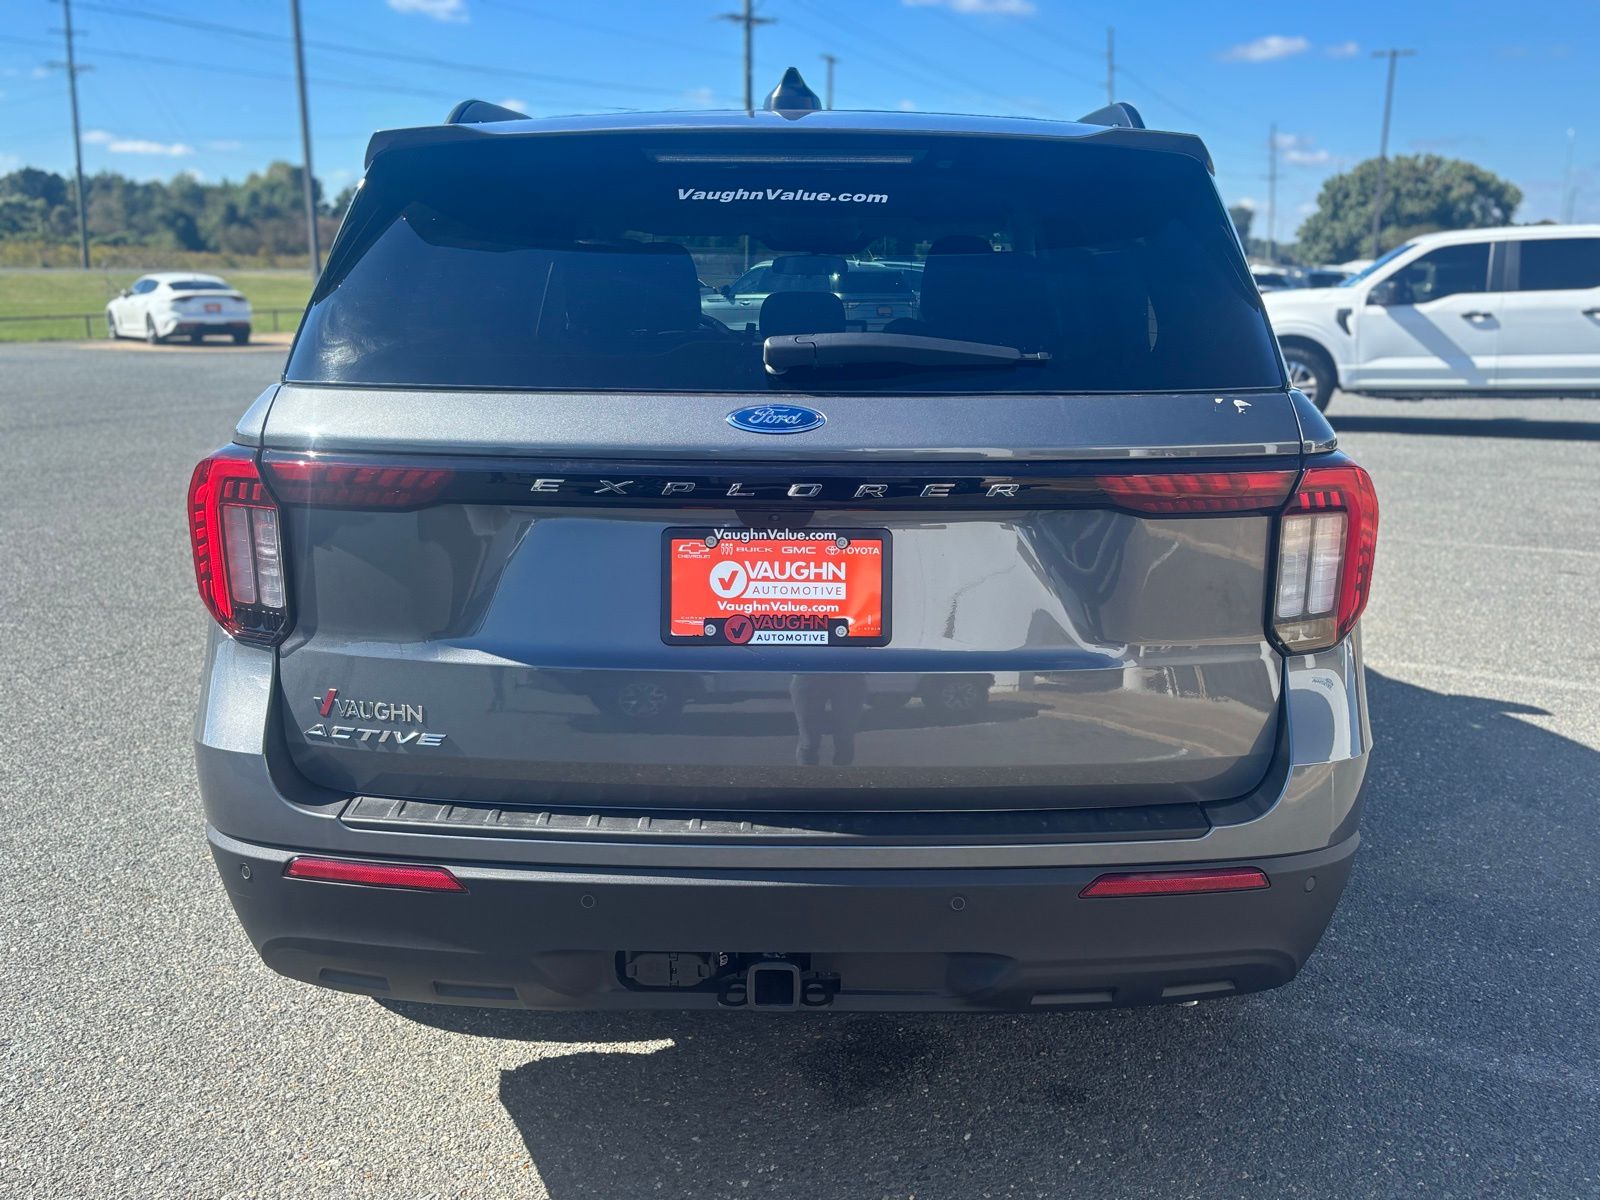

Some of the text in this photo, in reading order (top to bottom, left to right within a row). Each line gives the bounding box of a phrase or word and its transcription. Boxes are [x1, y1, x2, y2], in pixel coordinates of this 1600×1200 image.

[677, 188, 889, 204] VaughnValue.com
[748, 407, 802, 424] Ford
[530, 478, 1021, 498] EXPLORER
[713, 528, 837, 543] VaughnValue.com
[781, 546, 817, 555] GMC
[745, 561, 846, 580] VAUGHN
[752, 585, 842, 596] AUTOMOTIVE
[717, 601, 839, 613] VaughnValue.com
[750, 615, 829, 629] VAUGHN
[756, 633, 826, 642] AUTOMOTIVE
[334, 698, 424, 724] VAUGHN
[304, 723, 448, 747] ACTIVE
